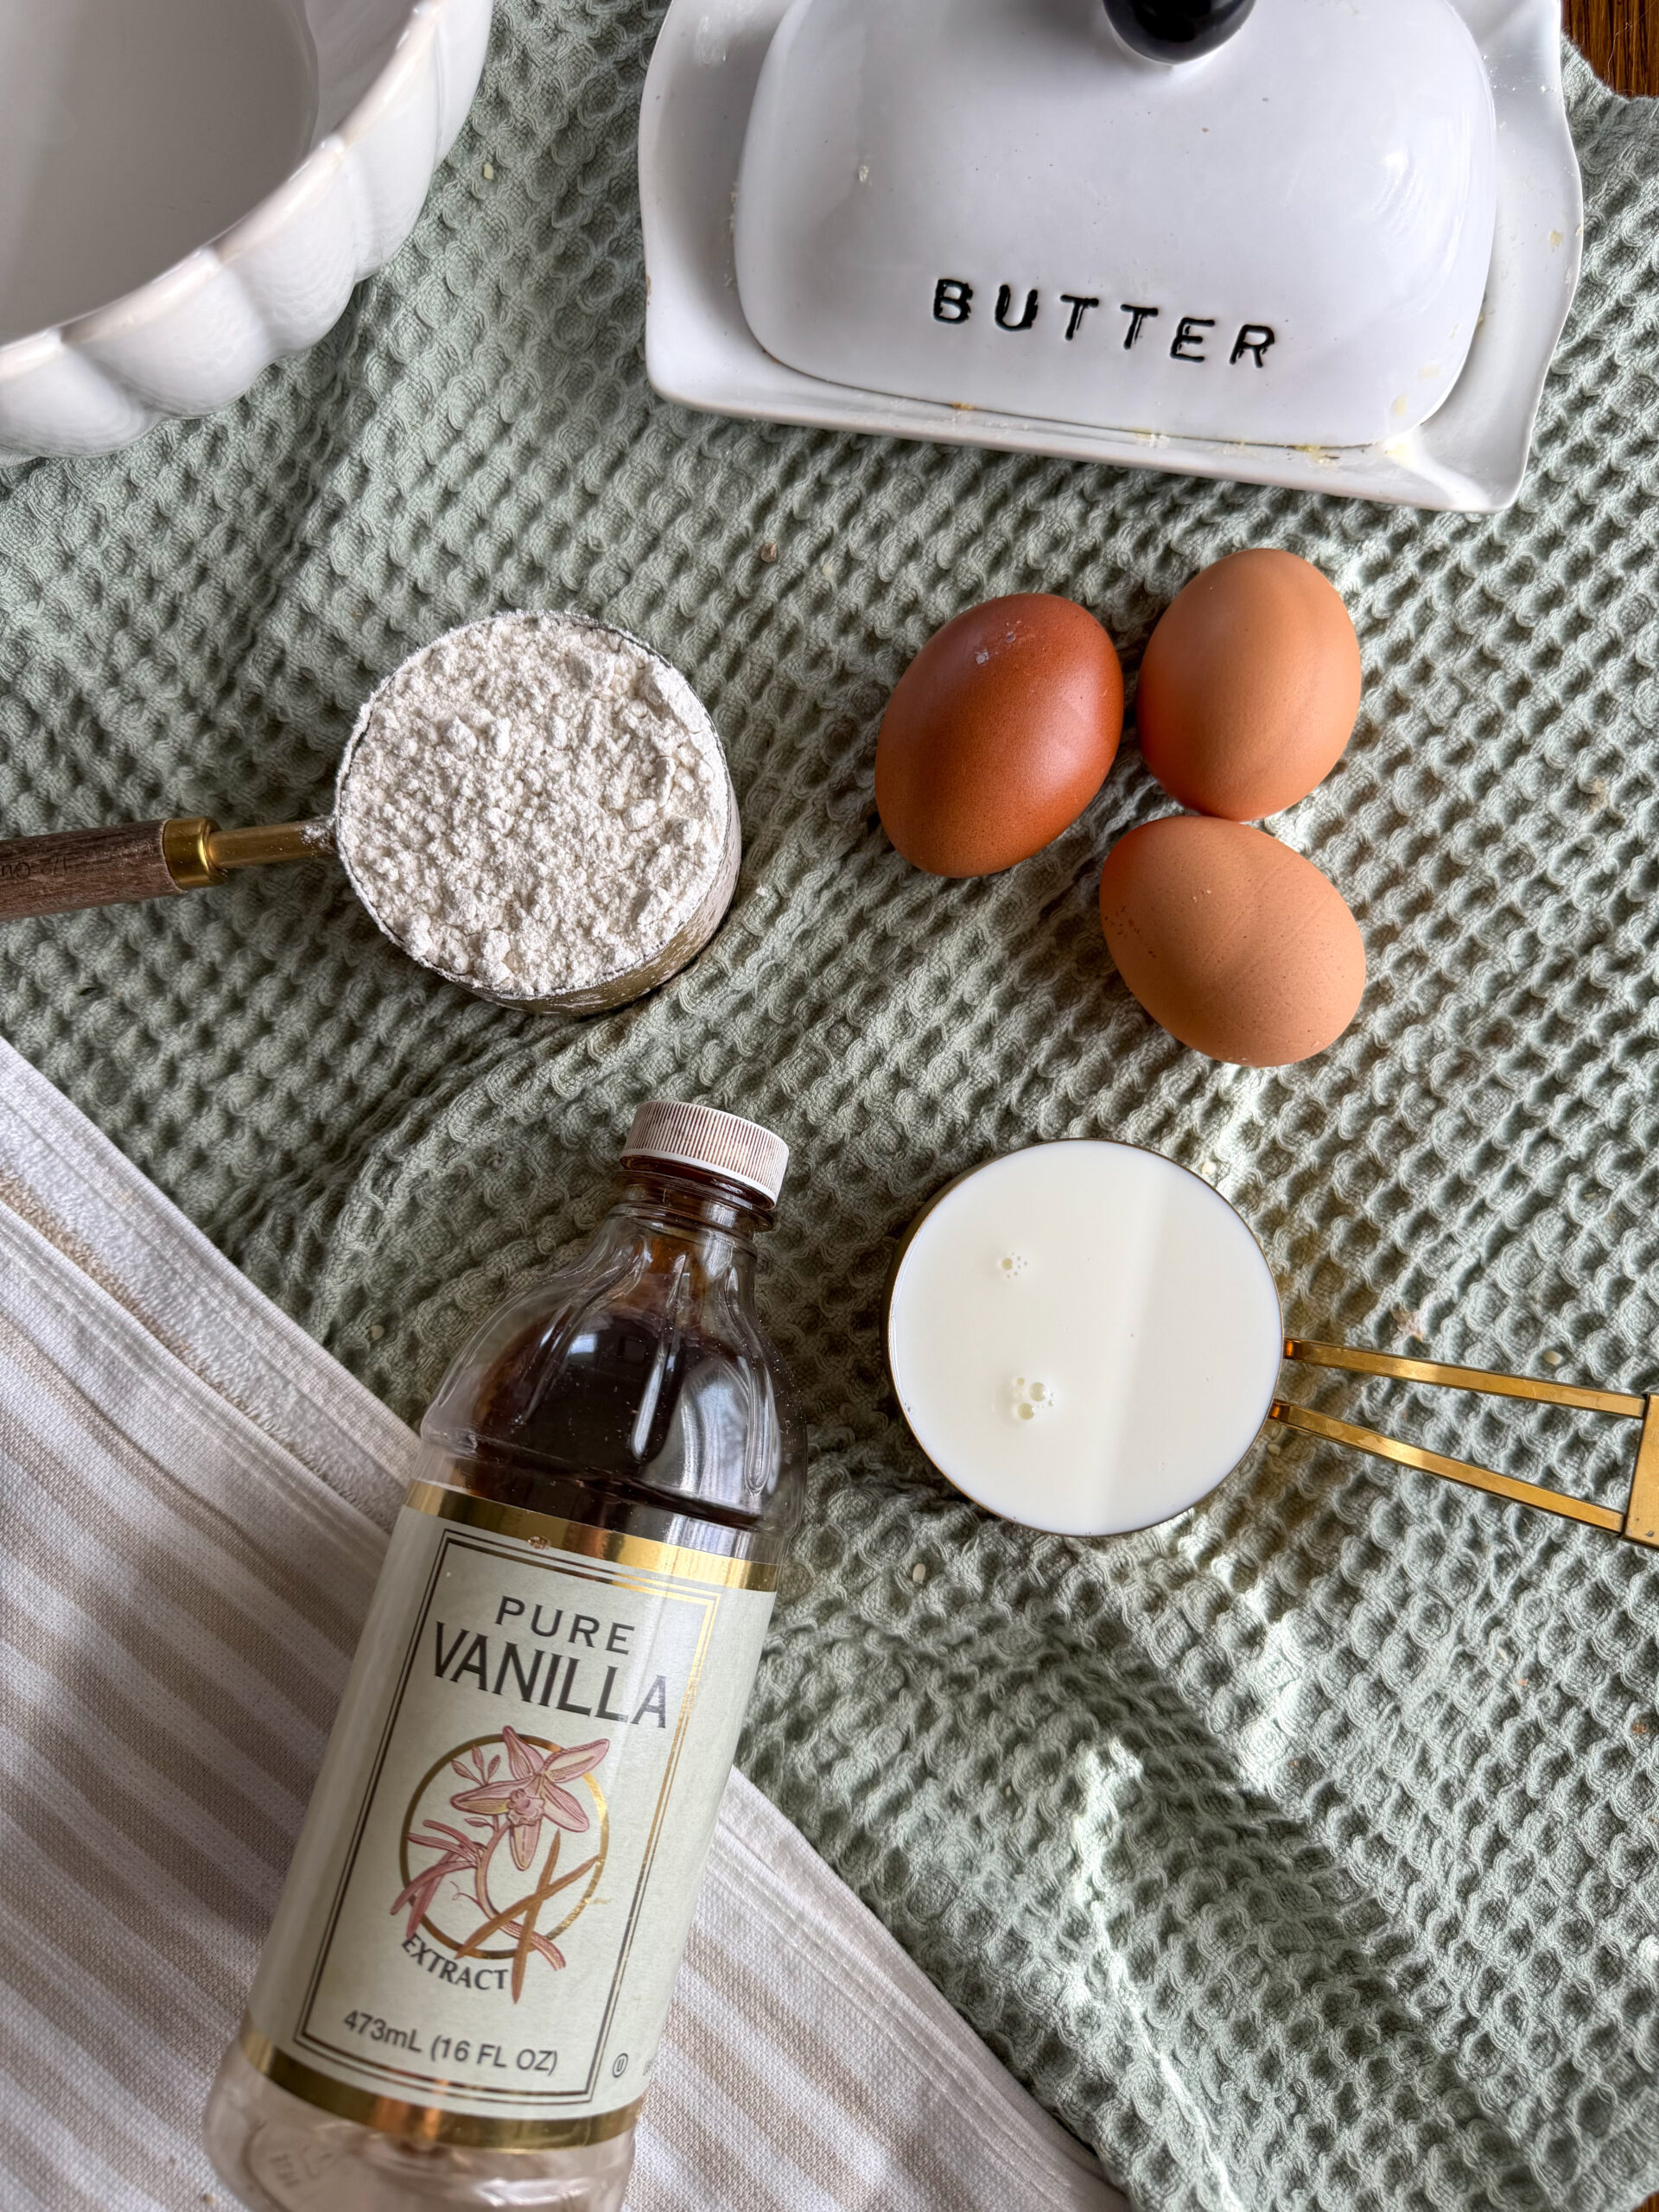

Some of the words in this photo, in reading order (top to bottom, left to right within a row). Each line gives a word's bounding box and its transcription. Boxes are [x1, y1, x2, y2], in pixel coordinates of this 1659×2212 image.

[932, 278, 1275, 369] BUTTER
[494, 1595, 636, 1655] PURE
[433, 1621, 667, 1729] VANILLA
[401, 1932, 509, 1991] EXTRACT
[343, 2010, 423, 2053] 473mL
[431, 2033, 470, 2063] (16
[476, 2044, 507, 2069] FL
[516, 2049, 558, 2076] OZ)
